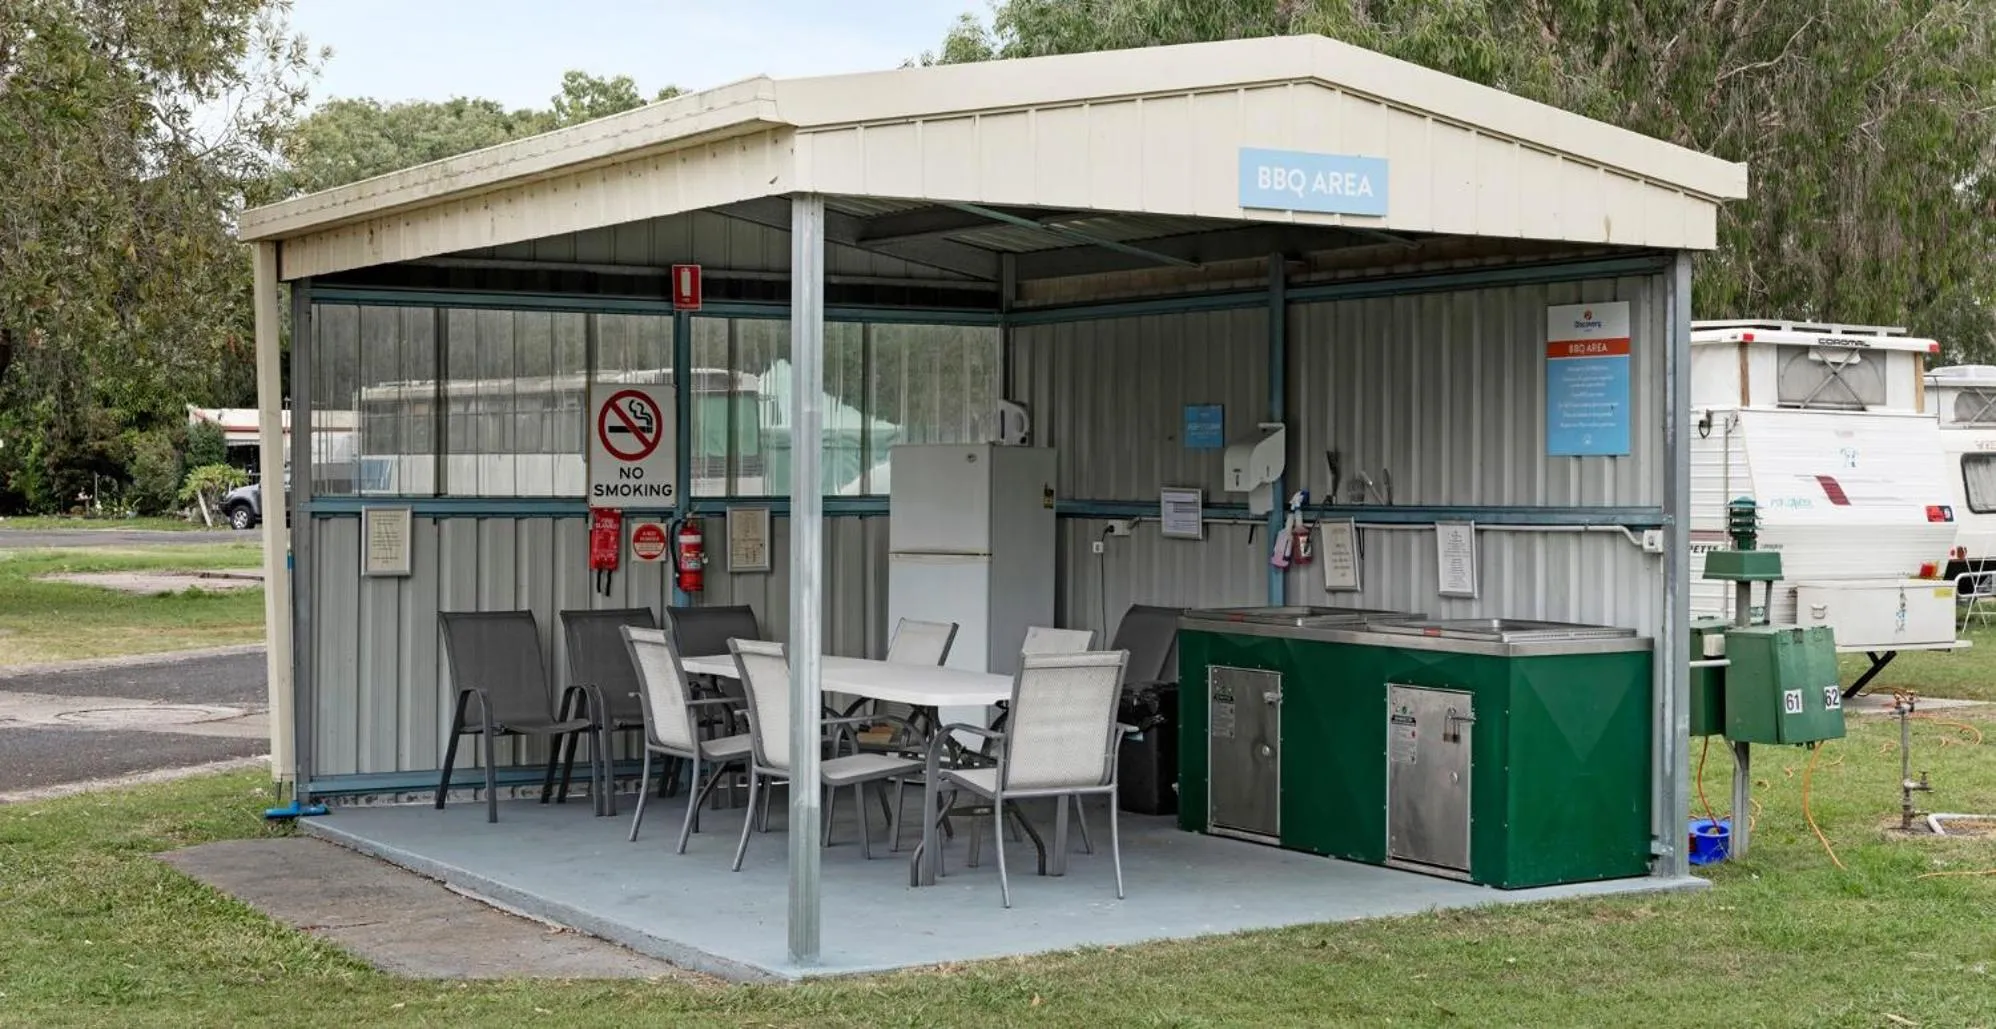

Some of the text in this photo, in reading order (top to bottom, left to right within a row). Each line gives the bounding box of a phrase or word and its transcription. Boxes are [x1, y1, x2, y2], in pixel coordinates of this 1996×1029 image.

[1257, 166, 1375, 199] BBQ AREA
[1568, 342, 1609, 355] BBQ AREA
[619, 466, 644, 480] NO
[593, 483, 673, 497] SMOKING
[1785, 692, 1801, 712] 61
[1824, 688, 1840, 708] 62
